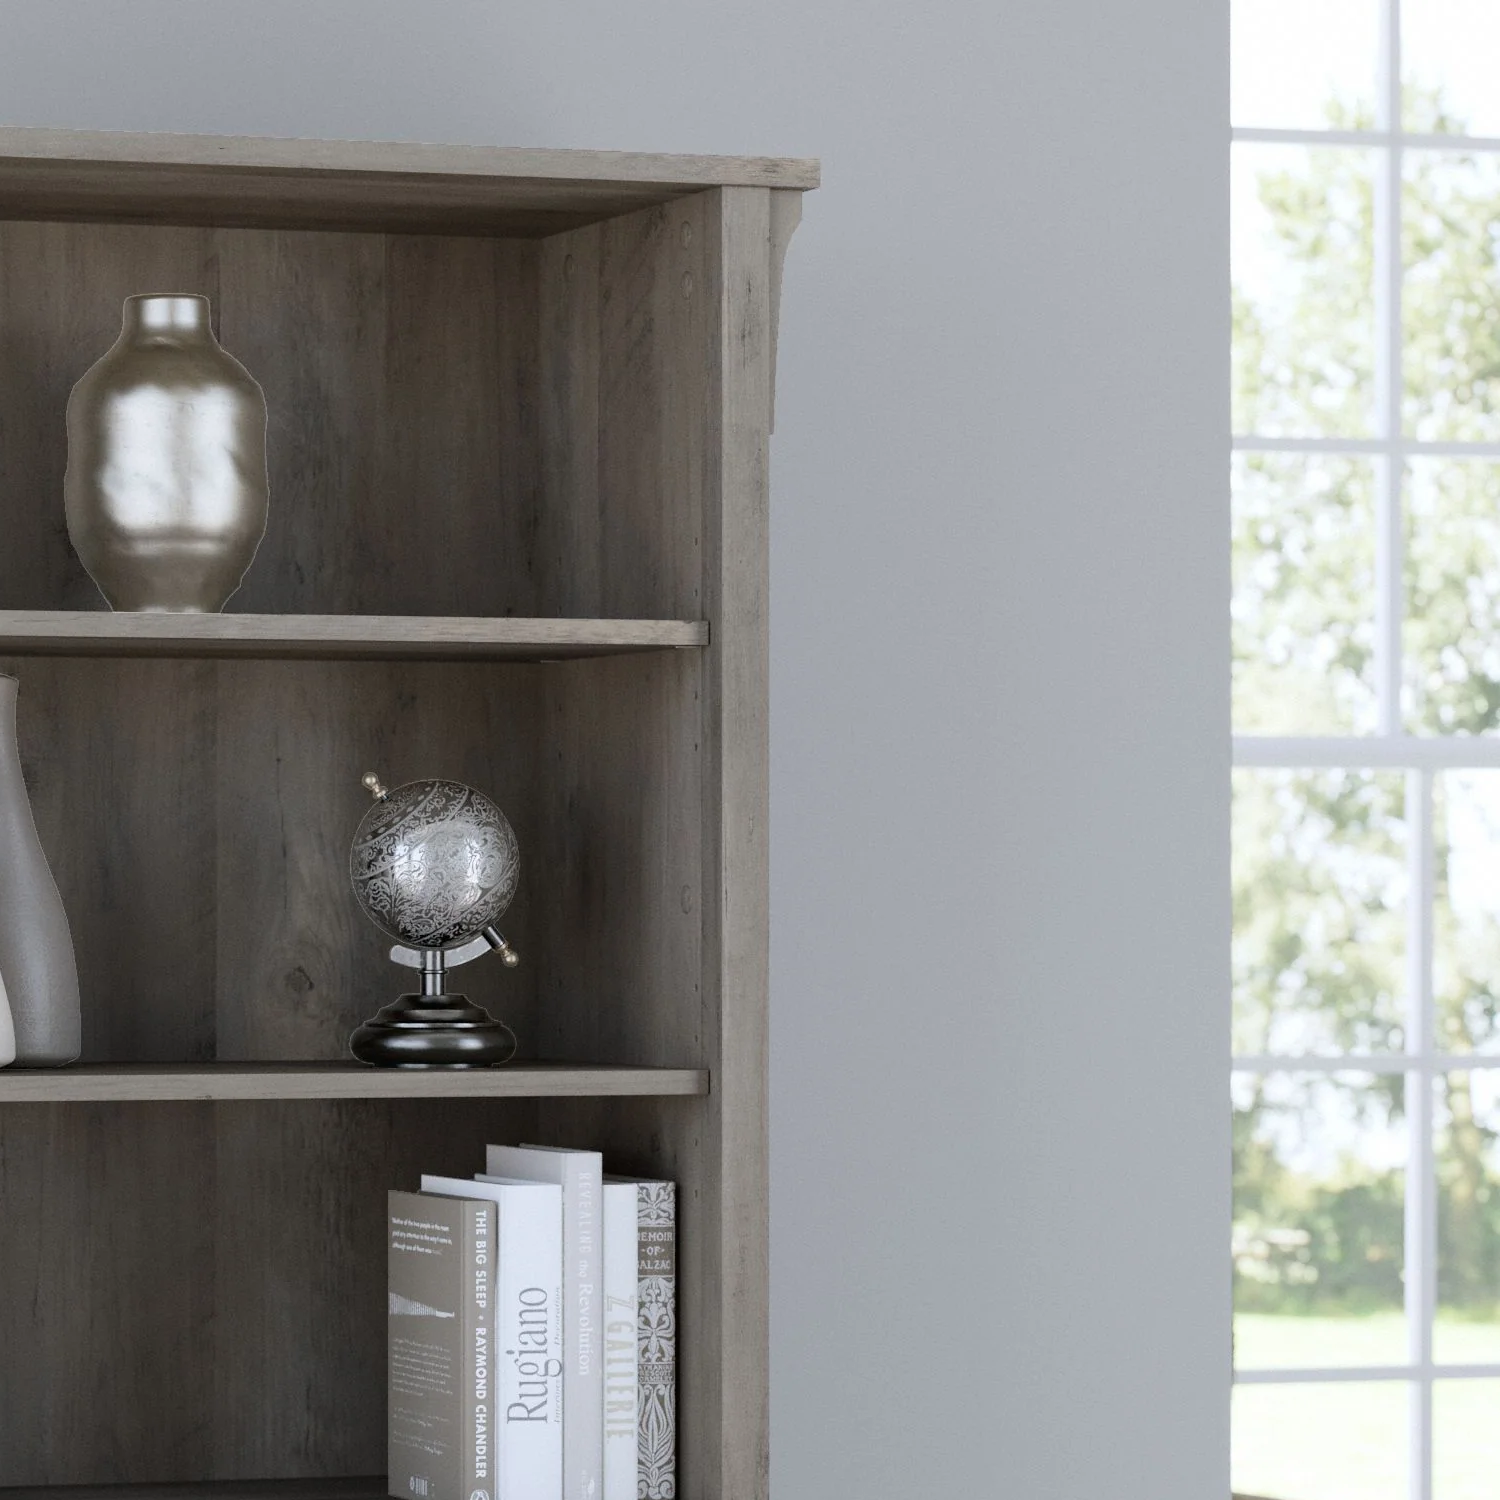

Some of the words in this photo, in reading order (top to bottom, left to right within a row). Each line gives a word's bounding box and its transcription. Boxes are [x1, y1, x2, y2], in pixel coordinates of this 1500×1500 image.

[475, 1210, 487, 1235] THE
[579, 1172, 592, 1253] REVEALING
[638, 1232, 673, 1241] EMOIR
[475, 1240, 487, 1265] BIG
[638, 1260, 670, 1269] ALZAC
[475, 1270, 487, 1308] SLEEP
[607, 1295, 634, 1312] Z
[505, 1287, 562, 1424] Rugiano
[579, 1284, 593, 1375] Revolution
[475, 1327, 487, 1400] RAYMOND
[607, 1321, 634, 1438] GALLERIE
[475, 1404, 487, 1479] CHANDLER
